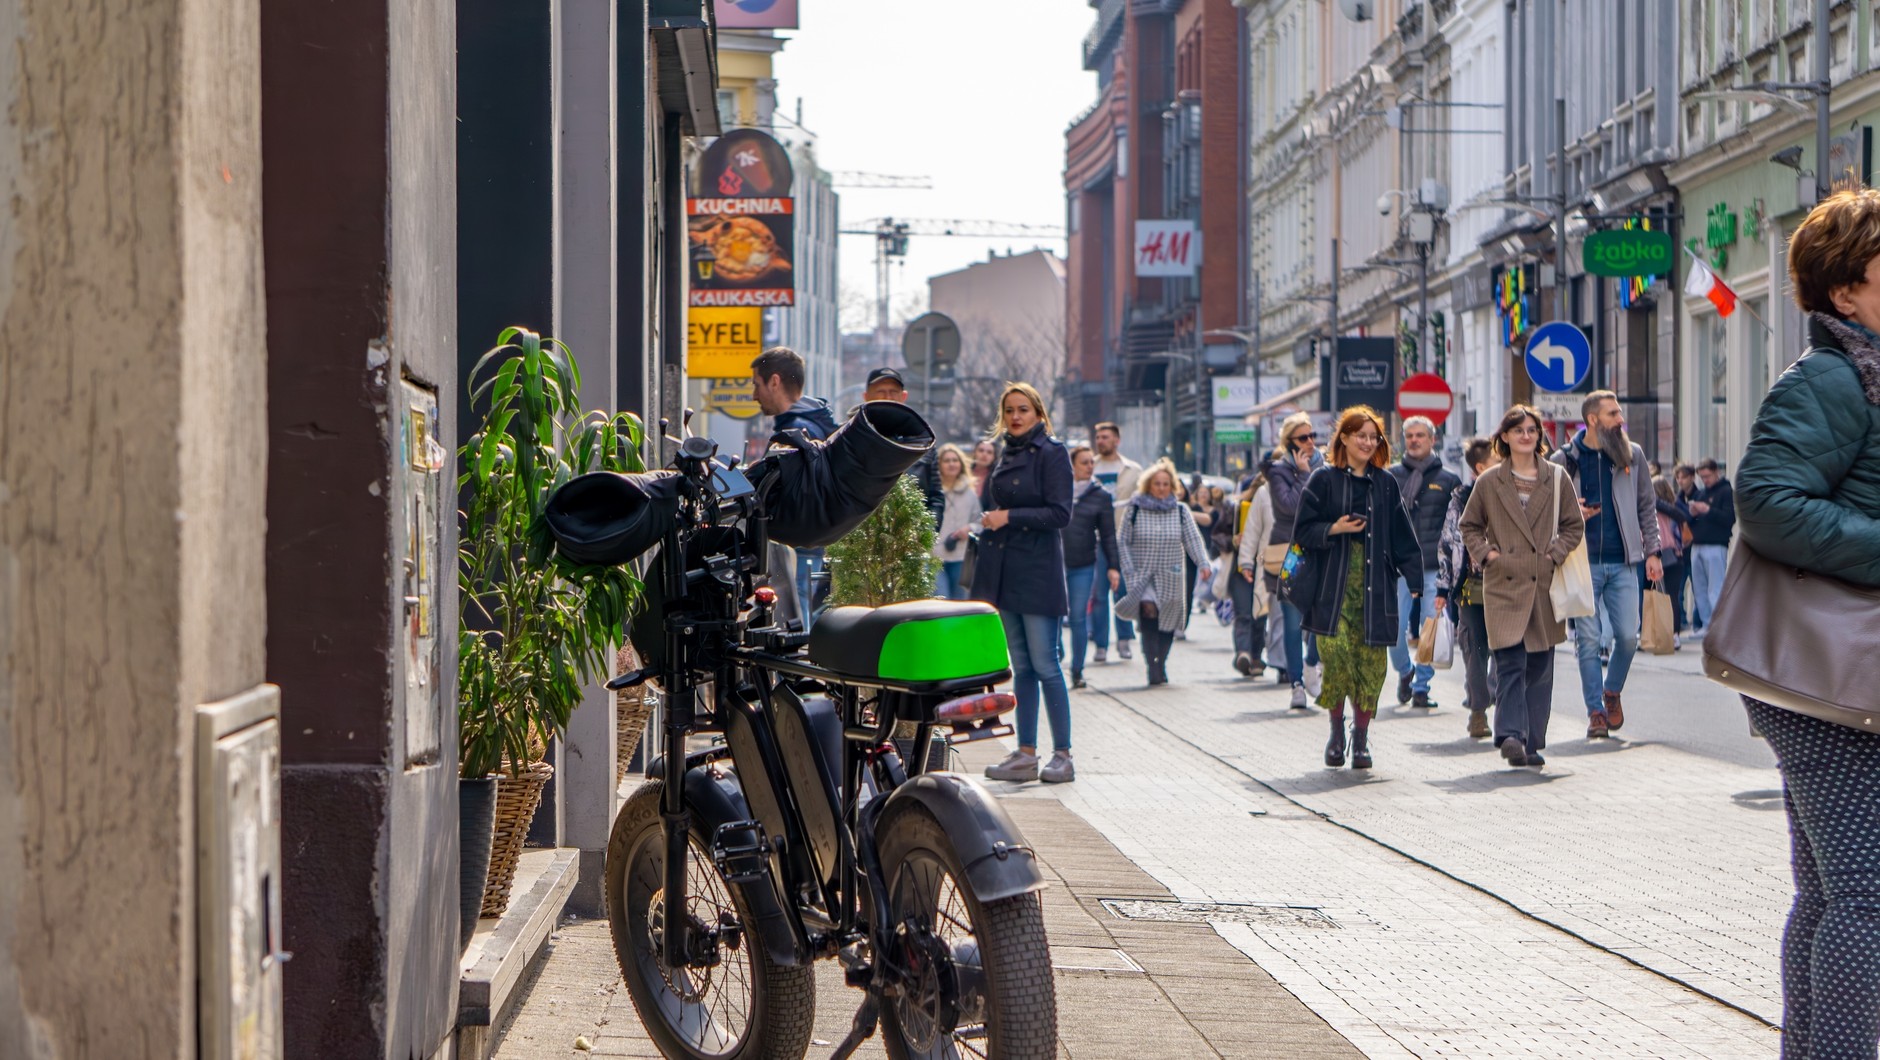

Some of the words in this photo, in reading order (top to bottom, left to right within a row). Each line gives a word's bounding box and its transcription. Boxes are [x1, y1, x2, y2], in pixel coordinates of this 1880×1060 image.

[695, 198, 784, 214] KUCHNIA
[1140, 230, 1191, 266] H&M
[1594, 241, 1664, 261] żabka
[690, 291, 791, 305] KAUKASKA
